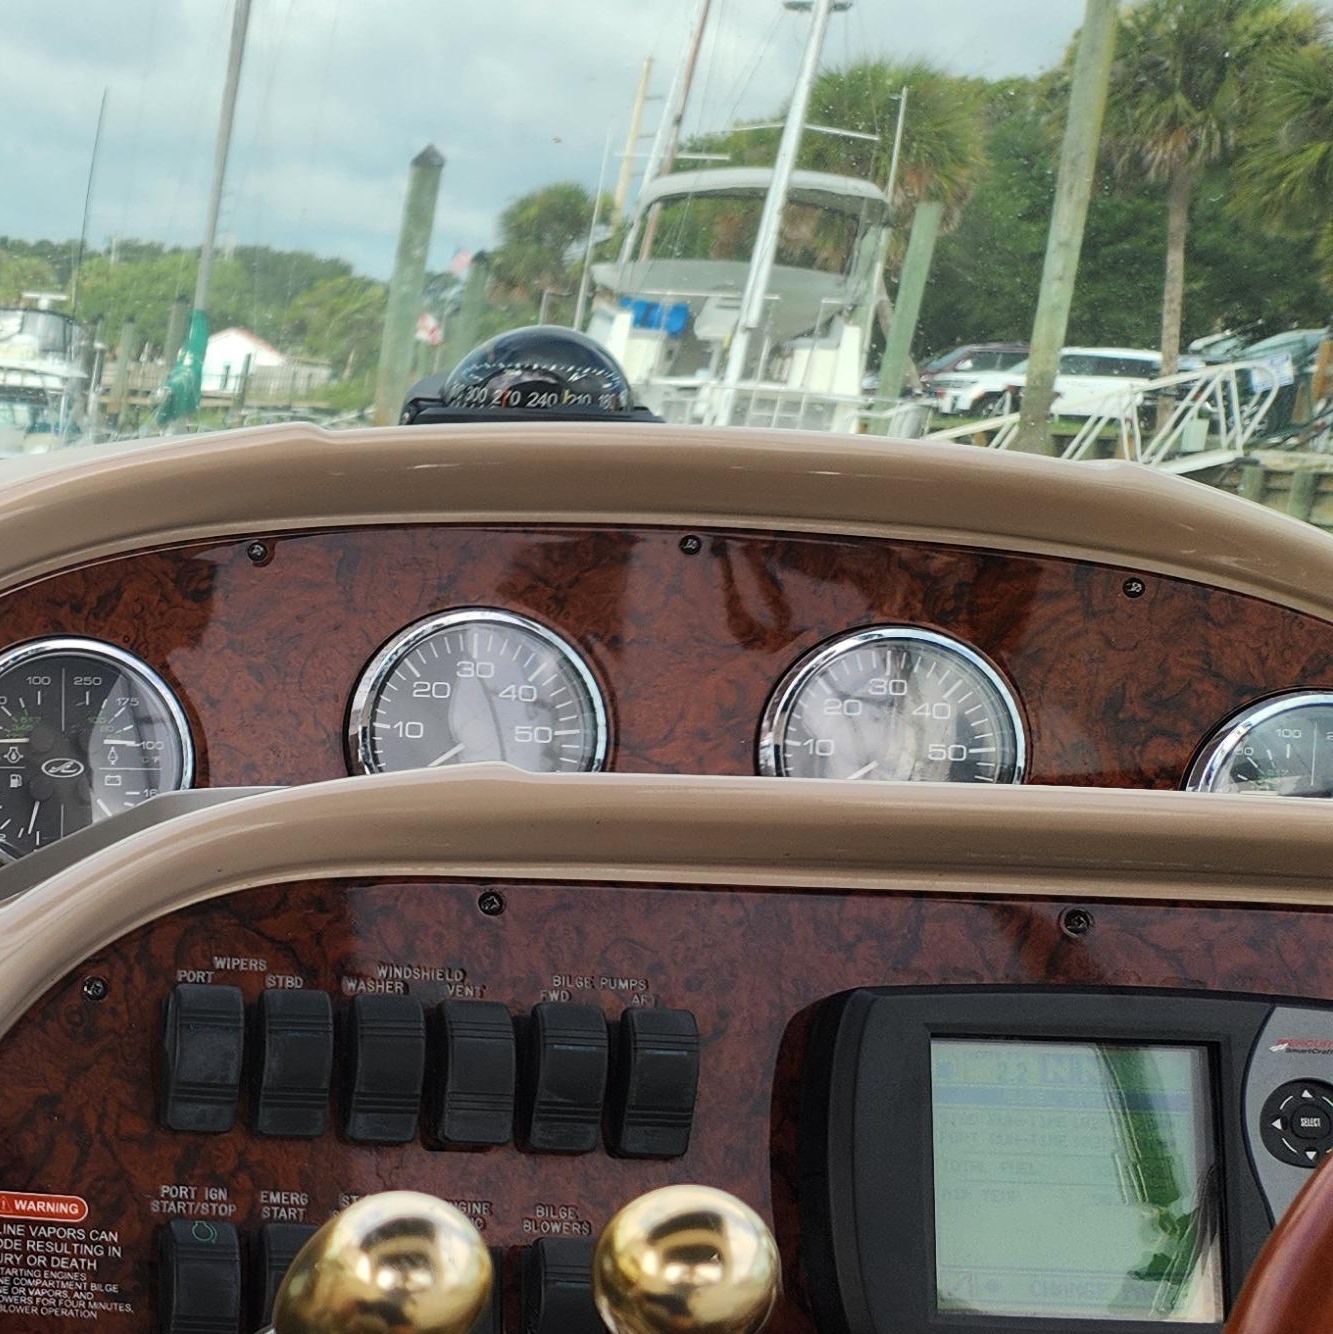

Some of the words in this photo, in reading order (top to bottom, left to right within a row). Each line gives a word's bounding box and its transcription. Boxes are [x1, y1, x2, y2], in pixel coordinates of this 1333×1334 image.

[527, 392, 558, 407] 240
[456, 659, 495, 679] 30
[26, 676, 51, 685] 100
[73, 676, 102, 686] 250
[868, 678, 908, 697] 30
[412, 680, 450, 700] 20
[499, 683, 537, 703] 40
[117, 697, 139, 707] 175
[823, 699, 863, 716] 20
[912, 702, 951, 720] 40
[393, 721, 424, 739] 10
[514, 725, 553, 744] 50
[1276, 728, 1302, 738] 100
[140, 741, 164, 750] 100
[803, 738, 835, 756] 10
[928, 743, 968, 762] 50
[213, 956, 268, 972] WIPERS
[177, 969, 215, 983] PORT
[265, 974, 304, 989] STBD
[377, 964, 465, 982] WINDSHIELD
[346, 978, 405, 994] WASHER
[552, 974, 591, 989] BILGE
[600, 976, 648, 991] PUMPS
[540, 990, 571, 1001] FWD
[1300, 1117, 1321, 1128] SELECT
[13, 1199, 79, 1215] WARNING
[160, 1185, 198, 1199] PORT
[205, 1187, 228, 1201] IGN
[260, 1190, 309, 1206] EMERG
[535, 1204, 578, 1219] BILGE
[150, 1200, 237, 1217] START/STOP
[261, 1206, 307, 1221] START
[522, 1219, 591, 1235] BLOWERS
[28, 1225, 85, 1240] VAPORS
[89, 1229, 118, 1243] CAN
[26, 1240, 104, 1257] RESULTING
[107, 1246, 122, 1258] IN
[26, 1254, 47, 1266] OR
[50, 1256, 97, 1270] DEATH
[43, 1269, 87, 1281] ENGINES
[11, 1286, 26, 1296] OR
[72, 1291, 94, 1300] AND
[12, 1276, 88, 1292] COMPARTMENT
[90, 1282, 119, 1294] BILGE
[35, 1297, 57, 1307] FOR
[58, 1299, 86, 1309] FOUR
[40, 1307, 98, 1320] OPERATION
